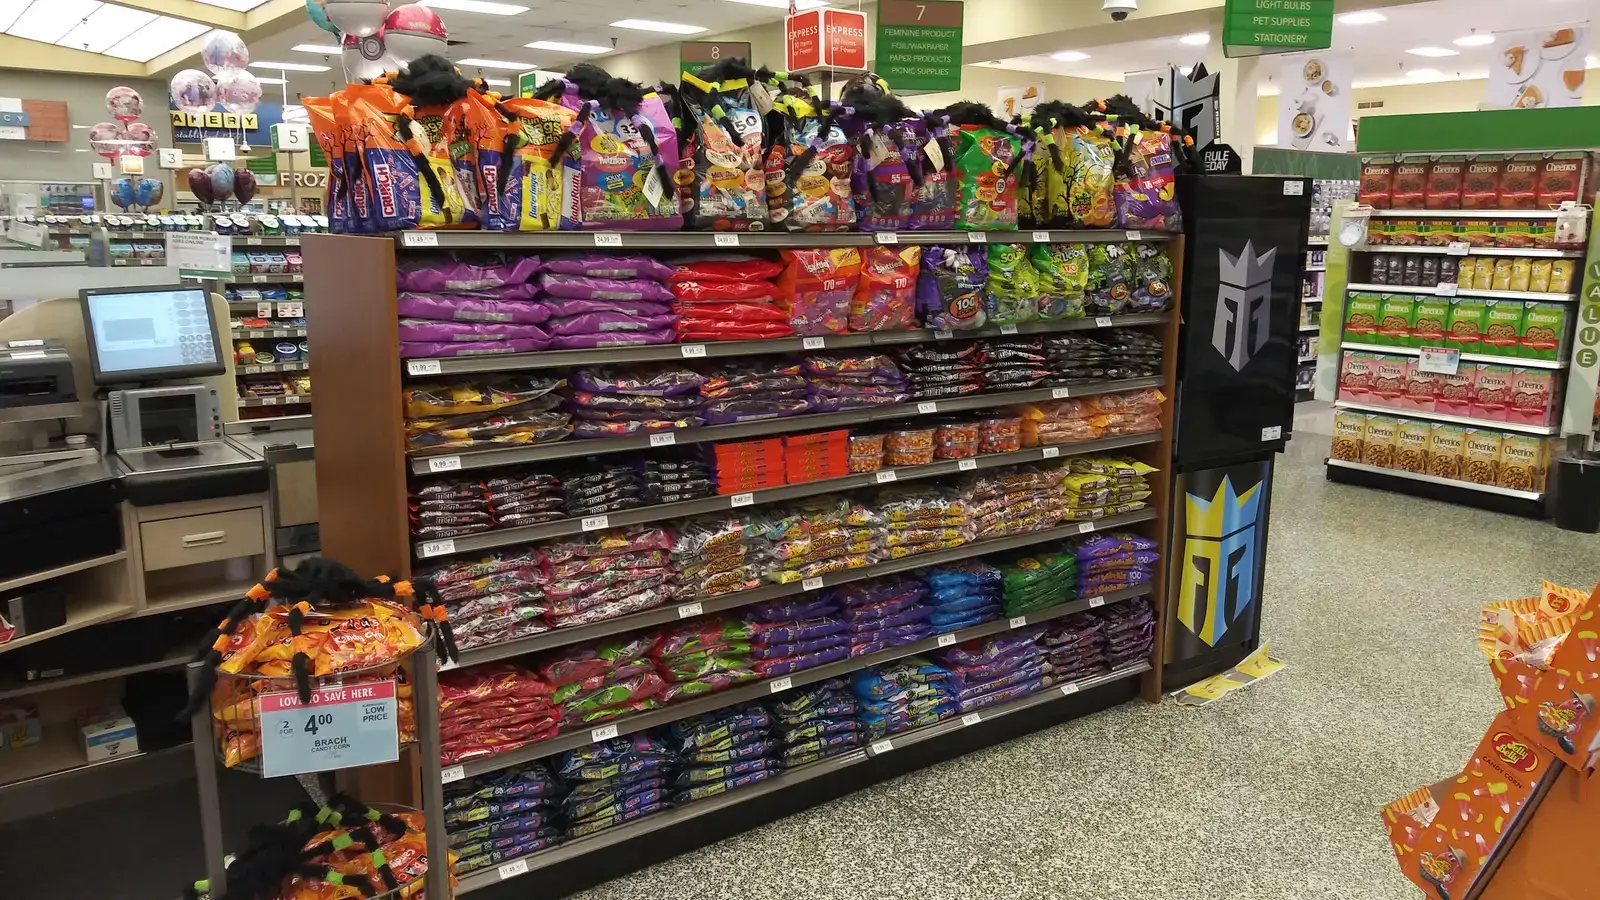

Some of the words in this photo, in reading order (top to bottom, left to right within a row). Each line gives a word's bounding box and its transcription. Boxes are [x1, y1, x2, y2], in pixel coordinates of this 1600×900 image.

[1256, 0, 1281, 9] LIGHT
[1284, 1, 1311, 10] BULBS
[916, 4, 926, 21] 7
[1253, 16, 1269, 25] PET
[1271, 17, 1310, 27] SUPPLIES
[789, 25, 818, 40] EXPRESS
[826, 25, 863, 37] EXPRESS
[884, 29, 920, 37] FEMININE
[921, 30, 956, 38] PRODUCT
[1254, 33, 1307, 43] STATIONERY
[891, 42, 949, 51] FOIL/WAXPAPER
[711, 46, 720, 60] 8
[889, 54, 911, 62] PAPER
[913, 55, 952, 63] PRODUCTS
[891, 67, 915, 75] PICNIC
[917, 68, 949, 76] SUPPLIES
[525, 120, 562, 135] Bags
[620, 123, 638, 135] 33
[289, 130, 298, 144] 5
[168, 153, 176, 164] 3
[1204, 150, 1229, 162] RULE
[891, 174, 901, 183] 55
[376, 166, 396, 216] CRUNCH
[484, 166, 498, 214] CRUNCH
[529, 171, 537, 219] Butterfinger
[408, 235, 424, 243] 11.49
[823, 279, 835, 290] 170
[894, 278, 907, 289] 170
[957, 296, 975, 311] 100
[411, 363, 427, 371] 11.99
[1347, 362, 1370, 371] Cheerios
[1378, 366, 1401, 375] Cheerios
[1480, 376, 1506, 386] Cheerios
[1518, 380, 1544, 390] Cheerios
[1336, 421, 1361, 432] Cheerios
[1368, 425, 1393, 437] Cheerios
[1400, 431, 1425, 442] Cheerios
[1433, 435, 1460, 447] Cheerios
[1467, 440, 1496, 452] Cheerios
[1504, 445, 1534, 457] Cheerios
[433, 460, 447, 469] 9.99
[1129, 571, 1142, 580] 100
[324, 691, 347, 702] SAVE
[351, 687, 377, 699] HERE.
[365, 706, 385, 715] LOW
[362, 713, 389, 723] PRICE
[283, 720, 290, 729] 2
[314, 736, 347, 748] BRACH
[311, 745, 332, 753] CANDY
[333, 743, 351, 751] CORN
[1507, 741, 1529, 760] Jelly
[1495, 744, 1520, 764] Belly
[1482, 755, 1504, 774] CANDY
[1504, 772, 1523, 789] CORN
